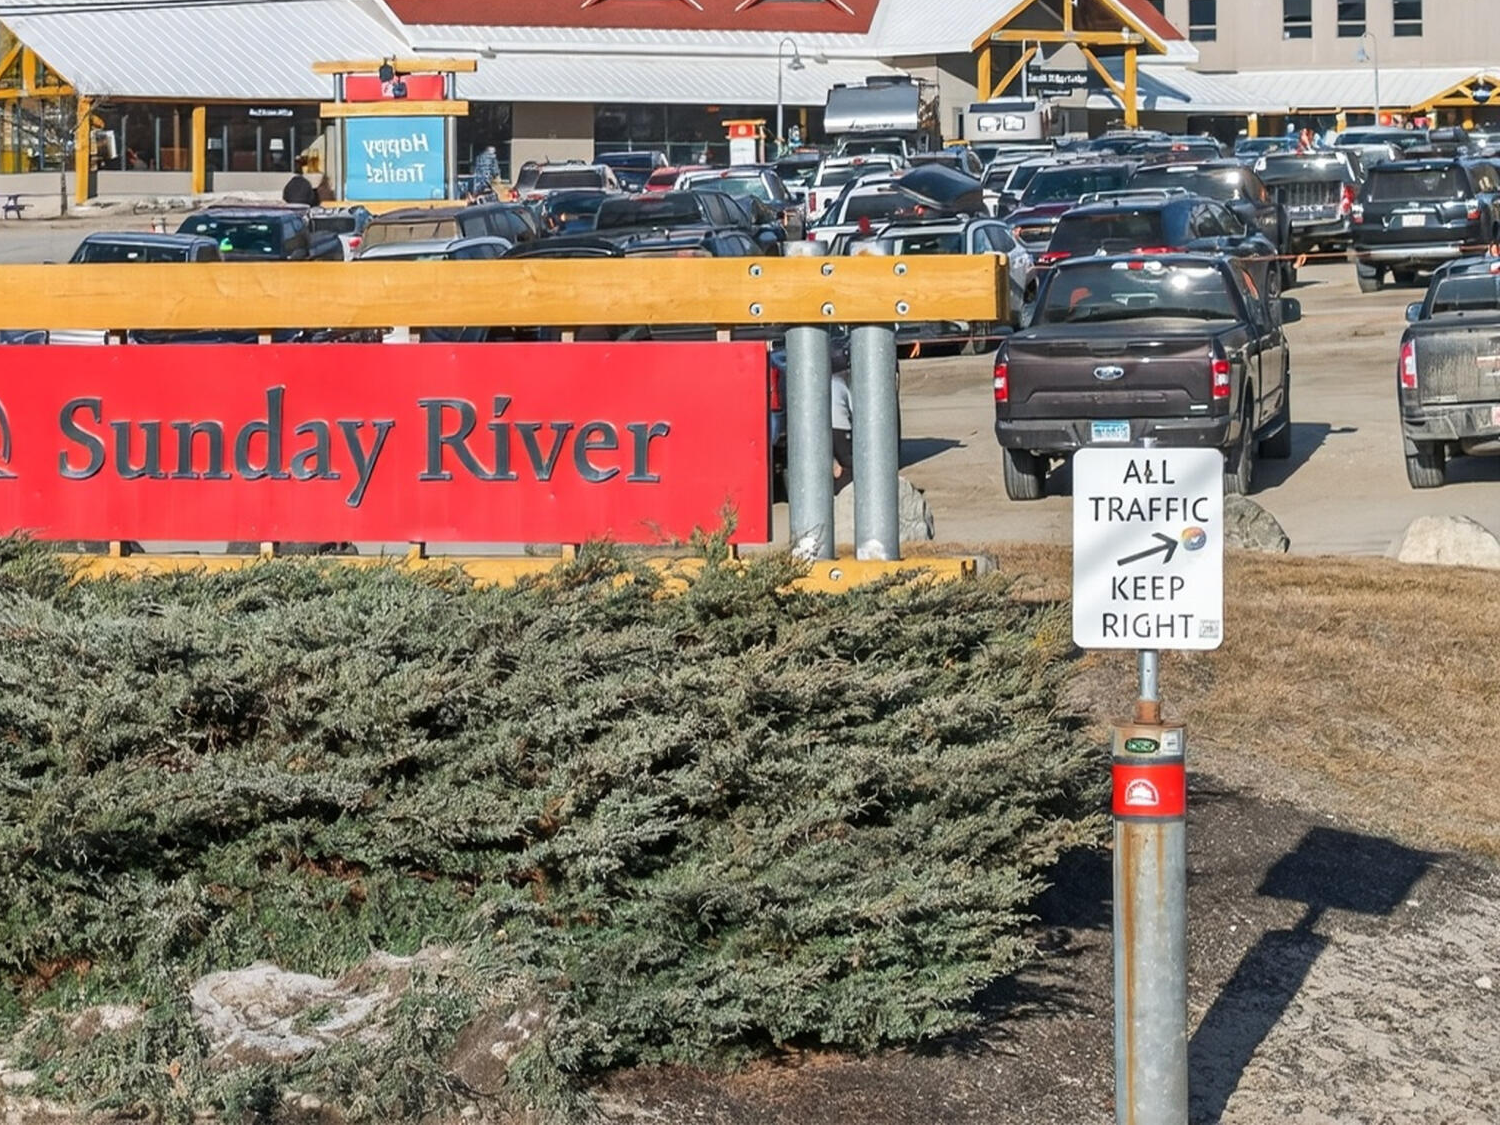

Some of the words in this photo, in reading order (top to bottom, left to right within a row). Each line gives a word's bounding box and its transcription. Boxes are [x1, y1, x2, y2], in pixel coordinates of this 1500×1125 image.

[57, 385, 396, 509] Sunday
[417, 394, 672, 484] River
[1123, 459, 1176, 486] ALL
[1088, 496, 1210, 523] TRAFFIC
[1111, 574, 1185, 602] KEEP
[1102, 612, 1194, 639] RIGHT
